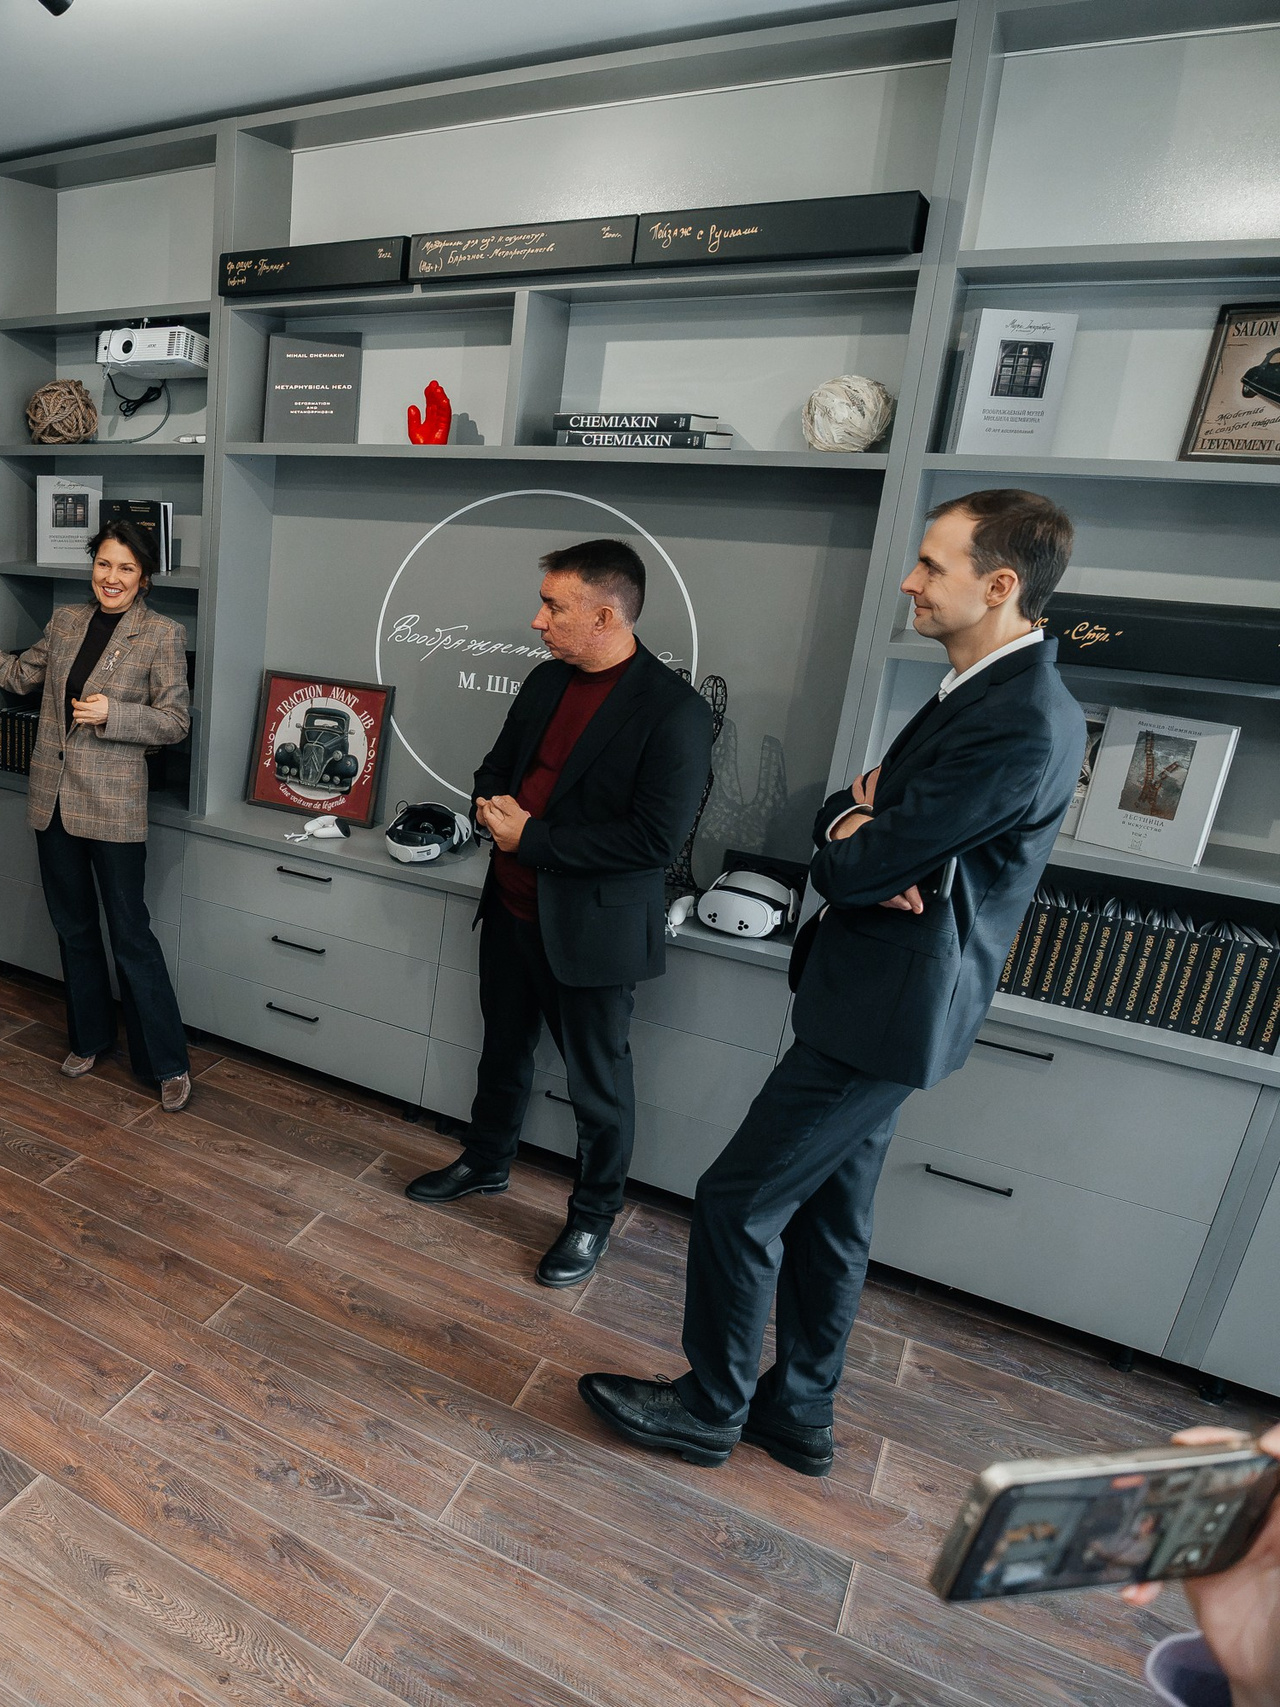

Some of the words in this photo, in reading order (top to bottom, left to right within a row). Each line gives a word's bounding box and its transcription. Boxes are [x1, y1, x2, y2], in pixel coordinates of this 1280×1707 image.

[1232, 321, 1278, 337] SALON
[570, 416, 659, 428] CHEMIAKIN
[582, 434, 672, 447] CHEMIAKIN
[276, 685, 323, 716] TRACTION
[329, 686, 359, 708] AVANT
[458, 671, 482, 691] М.
[485, 674, 523, 695] ШЕ
[290, 795, 312, 808] voiture
[313, 802, 321, 810] de
[1022, 935, 1042, 987] ВООБРАЖАЕМЫЙ
[1038, 913, 1048, 935] МУЗЕЙ
[1042, 940, 1062, 992] ВООБРАЖАЕМЫЙ
[1058, 917, 1068, 939] МУЗЕЙ
[1062, 944, 1083, 997] ВООБРАЖАЕМЫЙ
[1079, 922, 1090, 944] МУЗЕЙ
[1084, 949, 1105, 1002] ВООБРАЖАЕМЫЙ
[1100, 926, 1111, 949] МУЗЕЙ
[1105, 953, 1126, 1007] ВООБРАЖАЕМЫЙ
[1122, 931, 1133, 953] МУЗЕЙ
[1126, 958, 1148, 1011] ВООБРАЖАЕМЫЙ
[1143, 935, 1155, 958] МУЗЕЙ
[1147, 961, 1169, 1015] ВООБРАЖАЕМЫЙ
[1164, 938, 1176, 960] МУЗЕЙ
[1170, 966, 1193, 1020] ВООБРАЖАЕМЫЙ
[1187, 943, 1200, 966] МУЗЕЙ
[1191, 970, 1215, 1025] ВООБРАЖАЕМЫЙ
[1210, 947, 1223, 970] МУЗЕЙ
[1214, 976, 1238, 1031] ВООБРАЖАЕМЫЙ
[1233, 952, 1246, 976] МУЗЕЙ
[1237, 980, 1261, 1036] ВООБРАЖАЕМЫЙ
[1256, 957, 1270, 980] МУЗЕЙ
